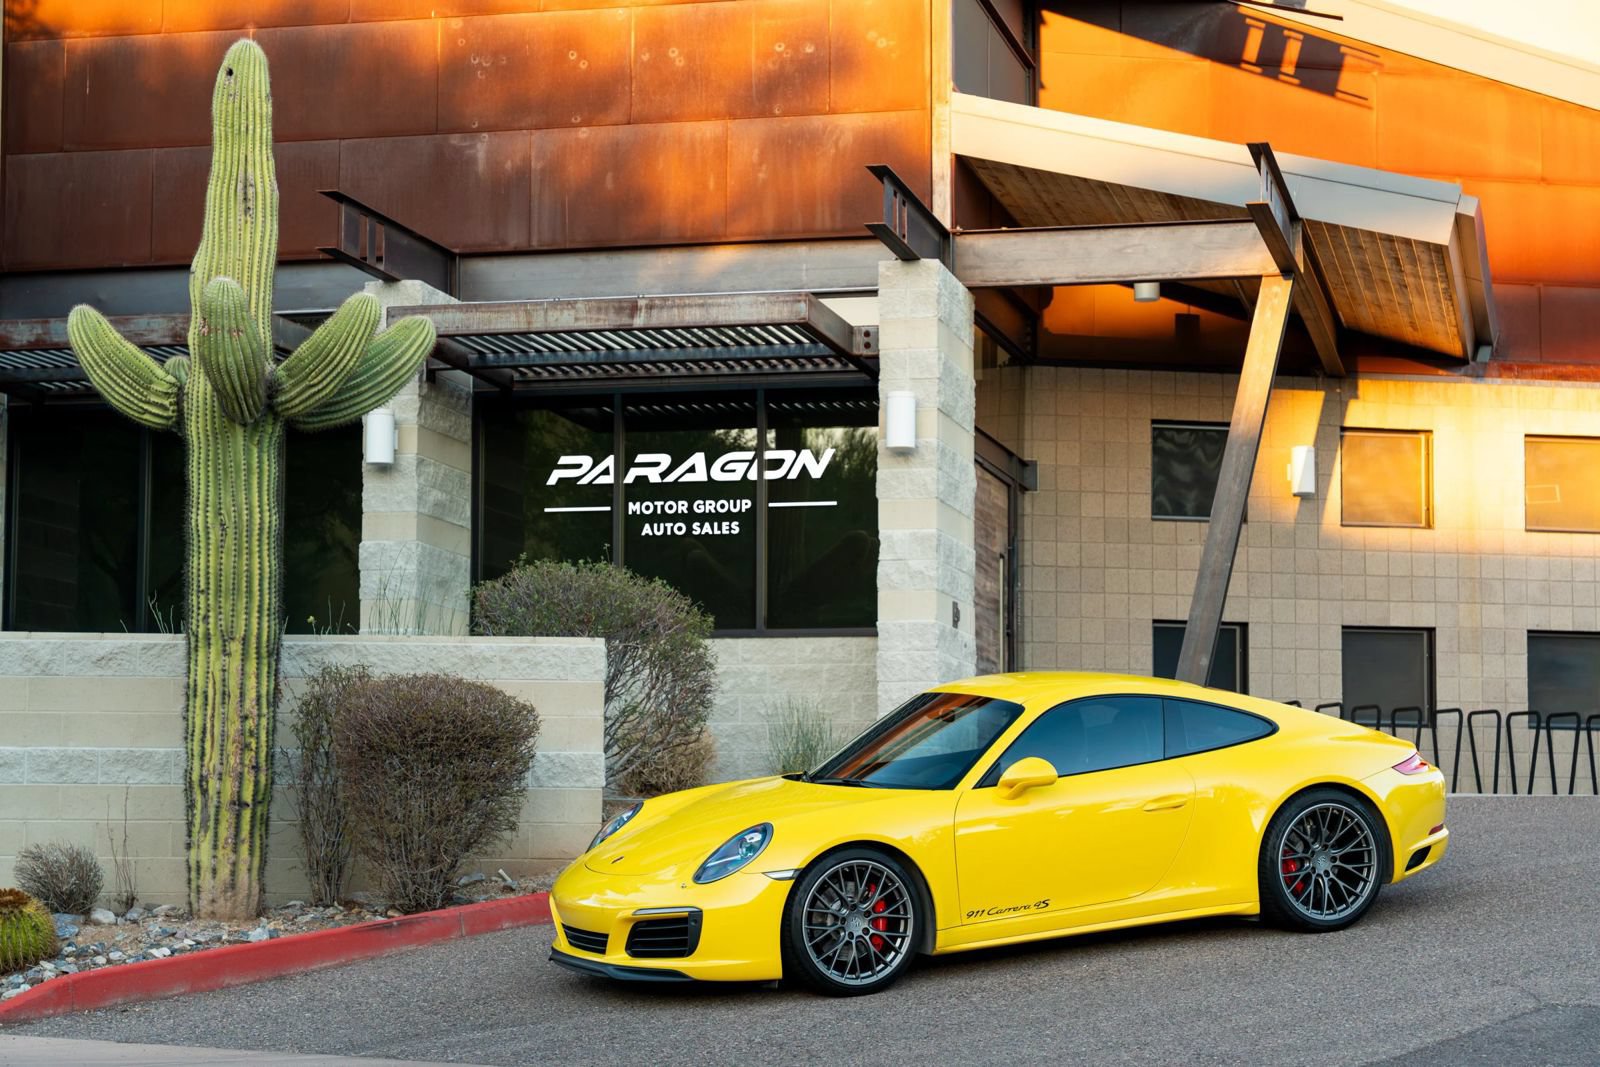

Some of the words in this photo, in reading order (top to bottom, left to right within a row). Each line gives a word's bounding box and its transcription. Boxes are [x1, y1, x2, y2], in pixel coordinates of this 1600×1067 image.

[545, 448, 836, 485] PARAGON
[627, 500, 688, 515] MOTOR
[692, 499, 752, 514] GROUP
[641, 522, 686, 536] AUTO
[692, 521, 740, 535] SALES
[966, 909, 986, 919] 911
[987, 905, 1031, 916] Carrera
